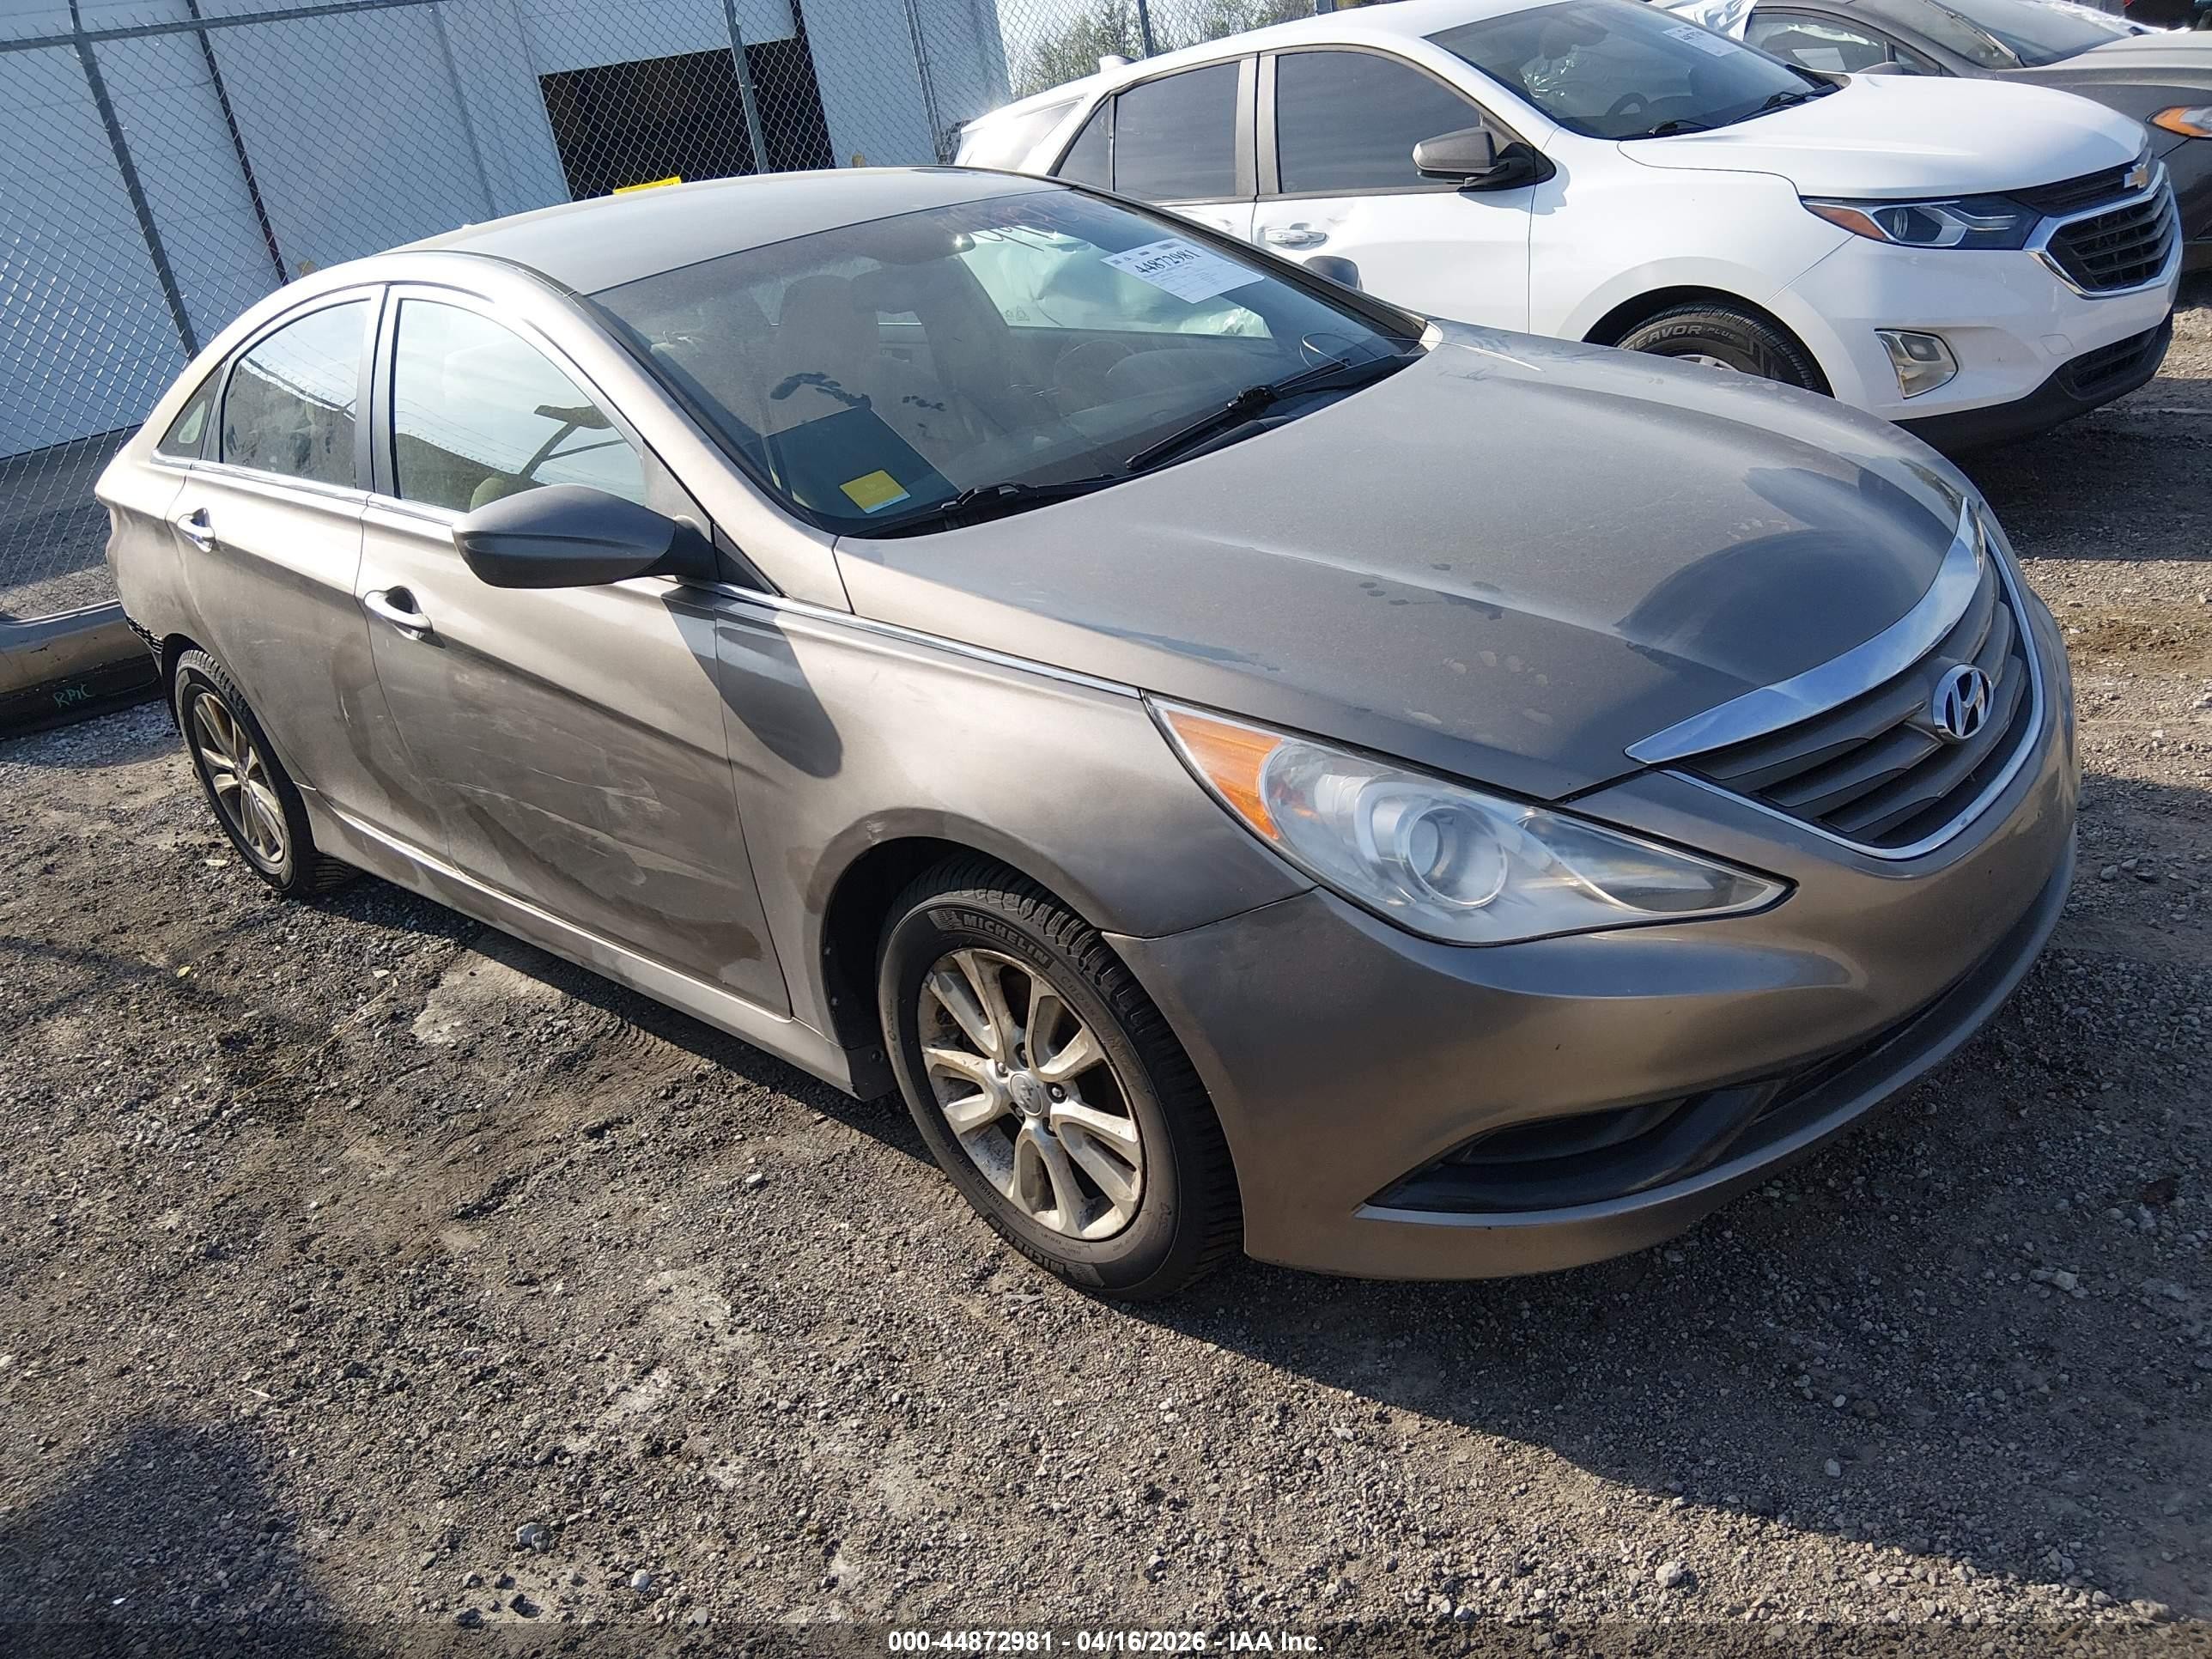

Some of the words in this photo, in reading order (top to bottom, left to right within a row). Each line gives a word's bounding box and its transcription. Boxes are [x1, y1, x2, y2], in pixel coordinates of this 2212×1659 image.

[1135, 248, 1202, 274] 44872981
[1707, 326, 1737, 340] PLUS
[963, 913, 1049, 966] MICHELIN
[988, 1215, 1066, 1275] MICHELIN
